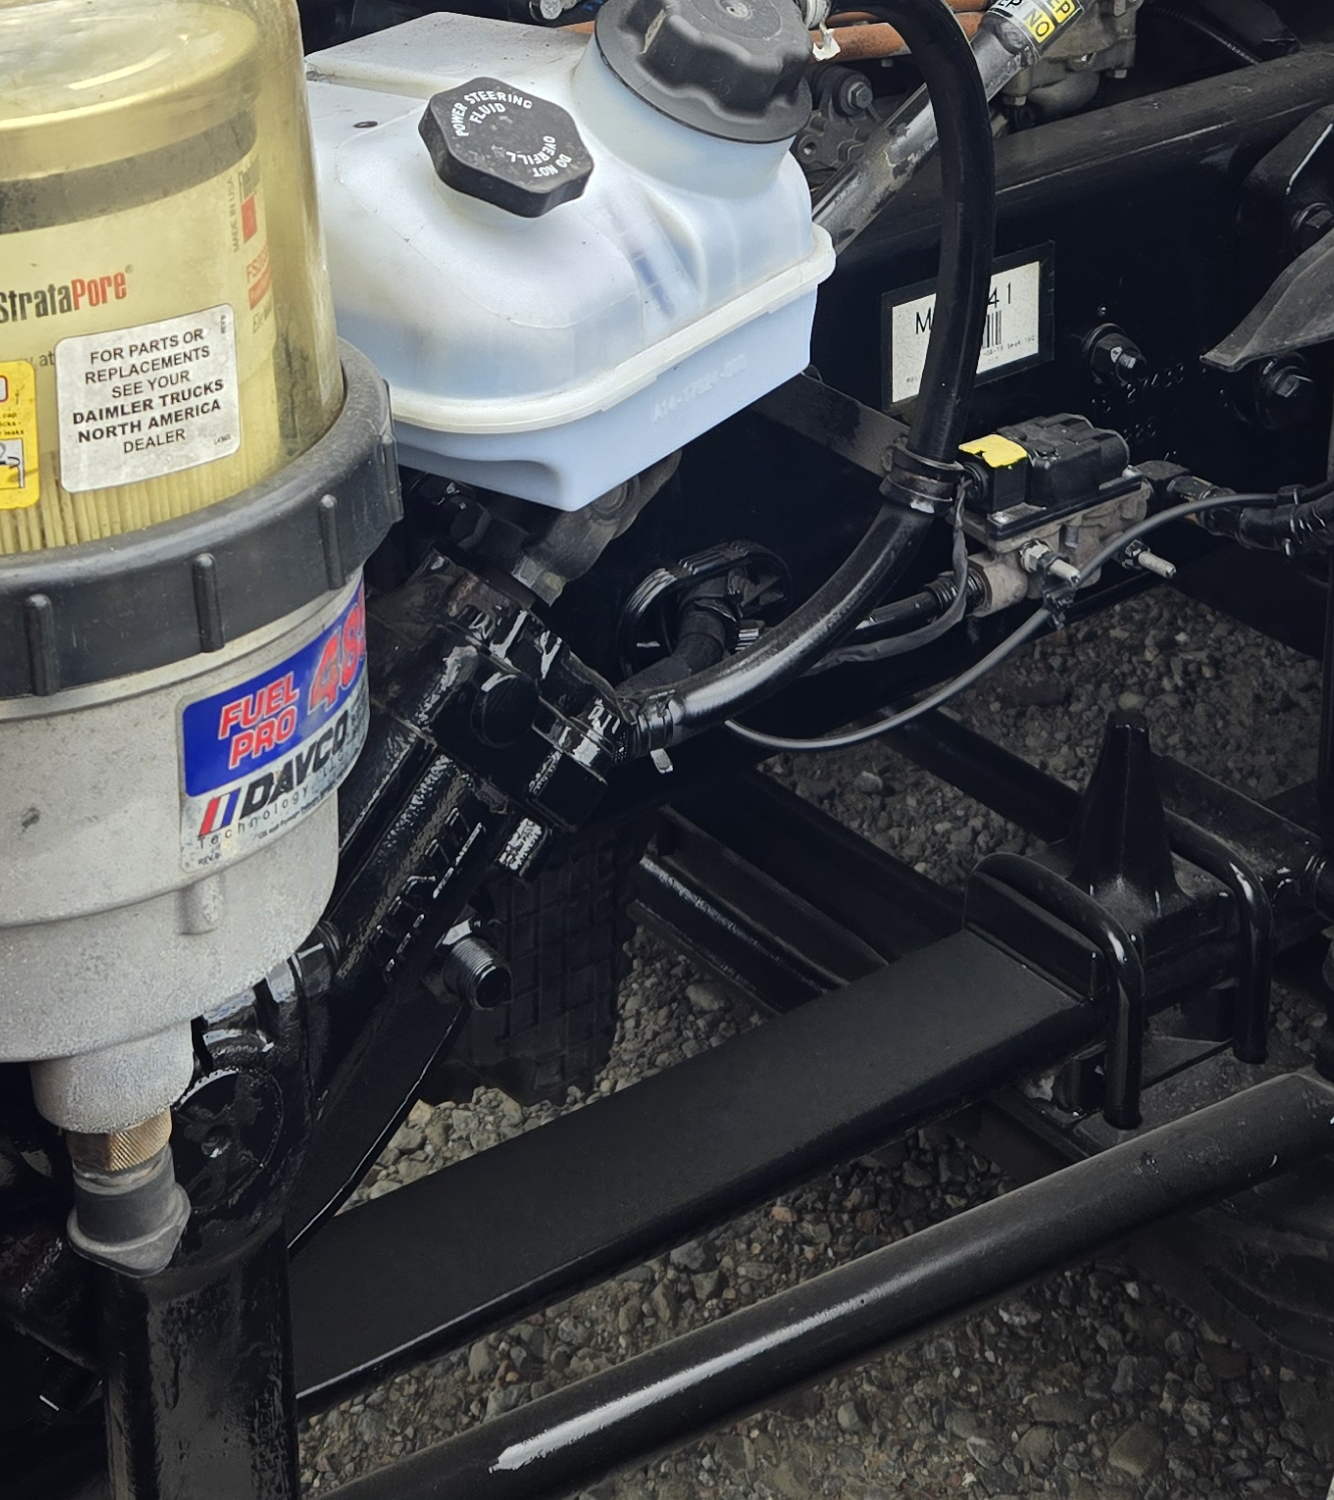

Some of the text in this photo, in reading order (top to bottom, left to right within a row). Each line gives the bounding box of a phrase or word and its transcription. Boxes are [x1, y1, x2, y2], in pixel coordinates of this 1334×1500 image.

[451, 90, 533, 137] POWER STEERING
[469, 102, 506, 124] FLUID
[505, 135, 557, 165] OVERFILL
[532, 166, 559, 178] NOT
[85, 345, 211, 385] REPLACEMENTS
[90, 328, 205, 366] FOR PARTS OR
[72, 378, 225, 425] DAIMLER TRUCKS
[112, 369, 191, 399] SEE YOUR
[2, 412, 18, 420] cap
[4, 428, 25, 436] leaks
[78, 399, 221, 444] NORTH AMERICA
[123, 428, 186, 454] DEALER
[217, 670, 300, 740] FUEL
[228, 704, 298, 770] PRO
[239, 709, 349, 820] DAVCO
[197, 785, 311, 850] Technology
